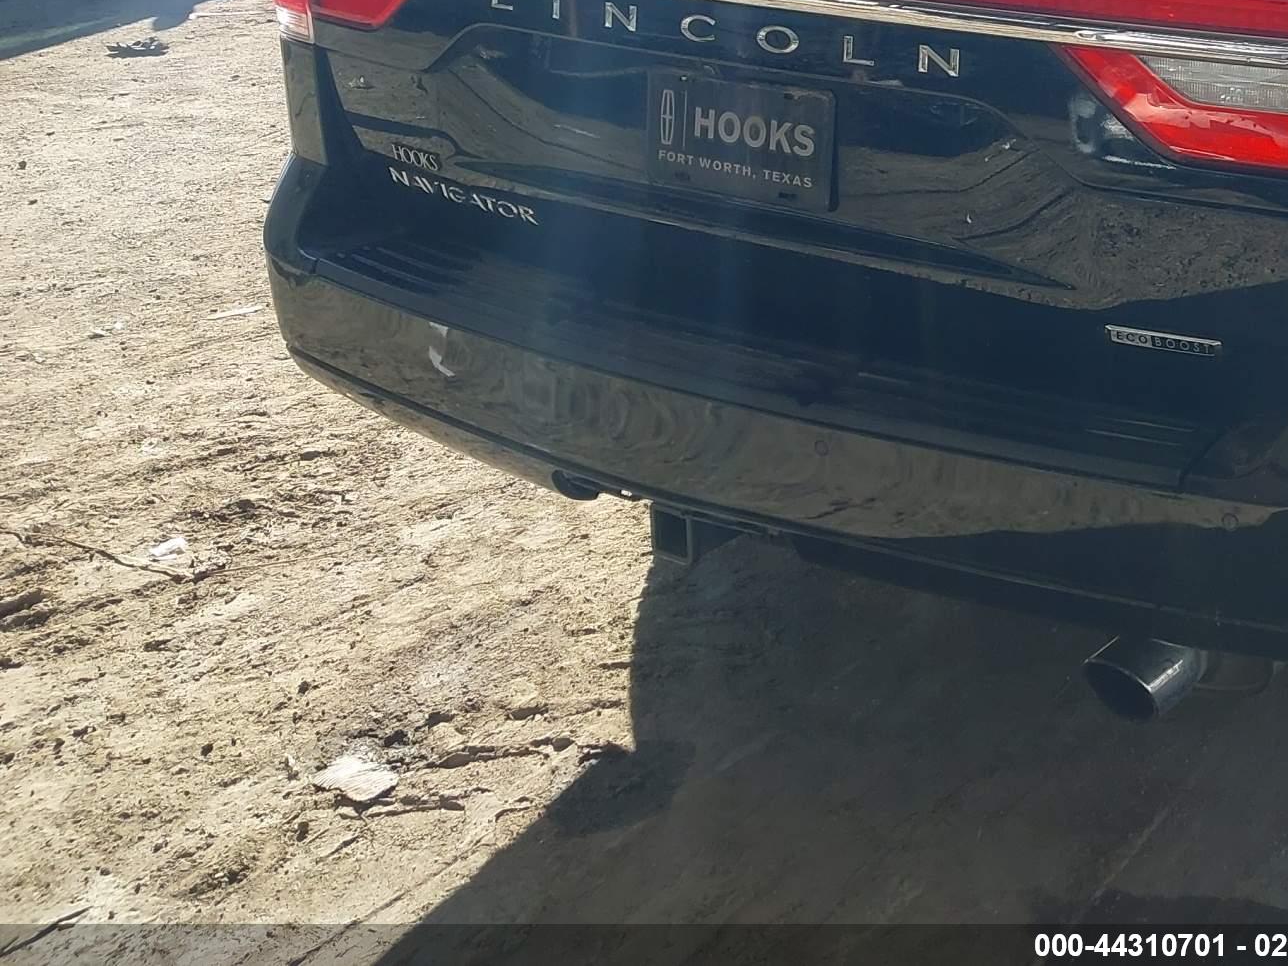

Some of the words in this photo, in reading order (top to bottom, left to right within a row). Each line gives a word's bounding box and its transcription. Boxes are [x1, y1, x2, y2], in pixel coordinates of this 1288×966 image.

[694, 107, 815, 157] HOOKS
[391, 144, 439, 172] HOOKS
[658, 149, 694, 166] FORT
[699, 156, 757, 180] WORTH,
[762, 169, 813, 189] TEXAS
[388, 166, 540, 226] NAVIGATOR
[1115, 330, 1212, 354] ECOBOOST
